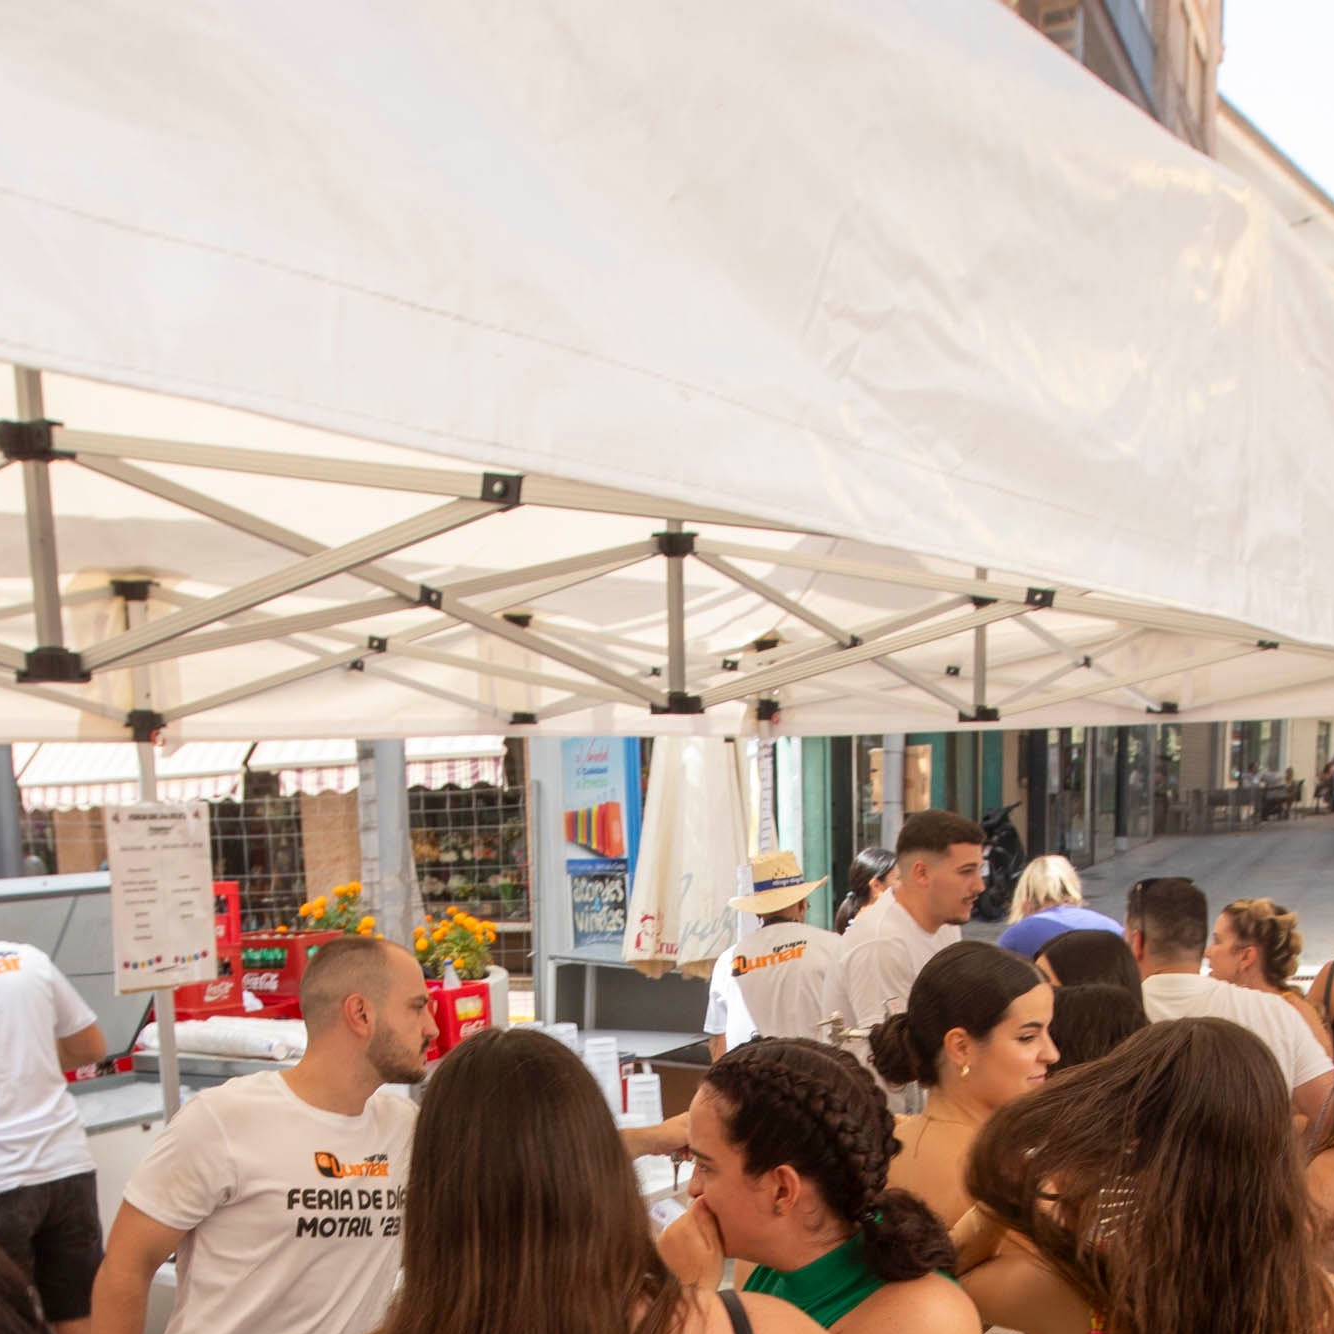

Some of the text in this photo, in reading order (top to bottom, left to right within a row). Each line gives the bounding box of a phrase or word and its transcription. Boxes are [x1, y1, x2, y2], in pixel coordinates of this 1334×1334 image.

[287, 1188, 353, 1210] FERIA
[357, 1189, 382, 1210] DE
[296, 1216, 373, 1238] MOTRIL
